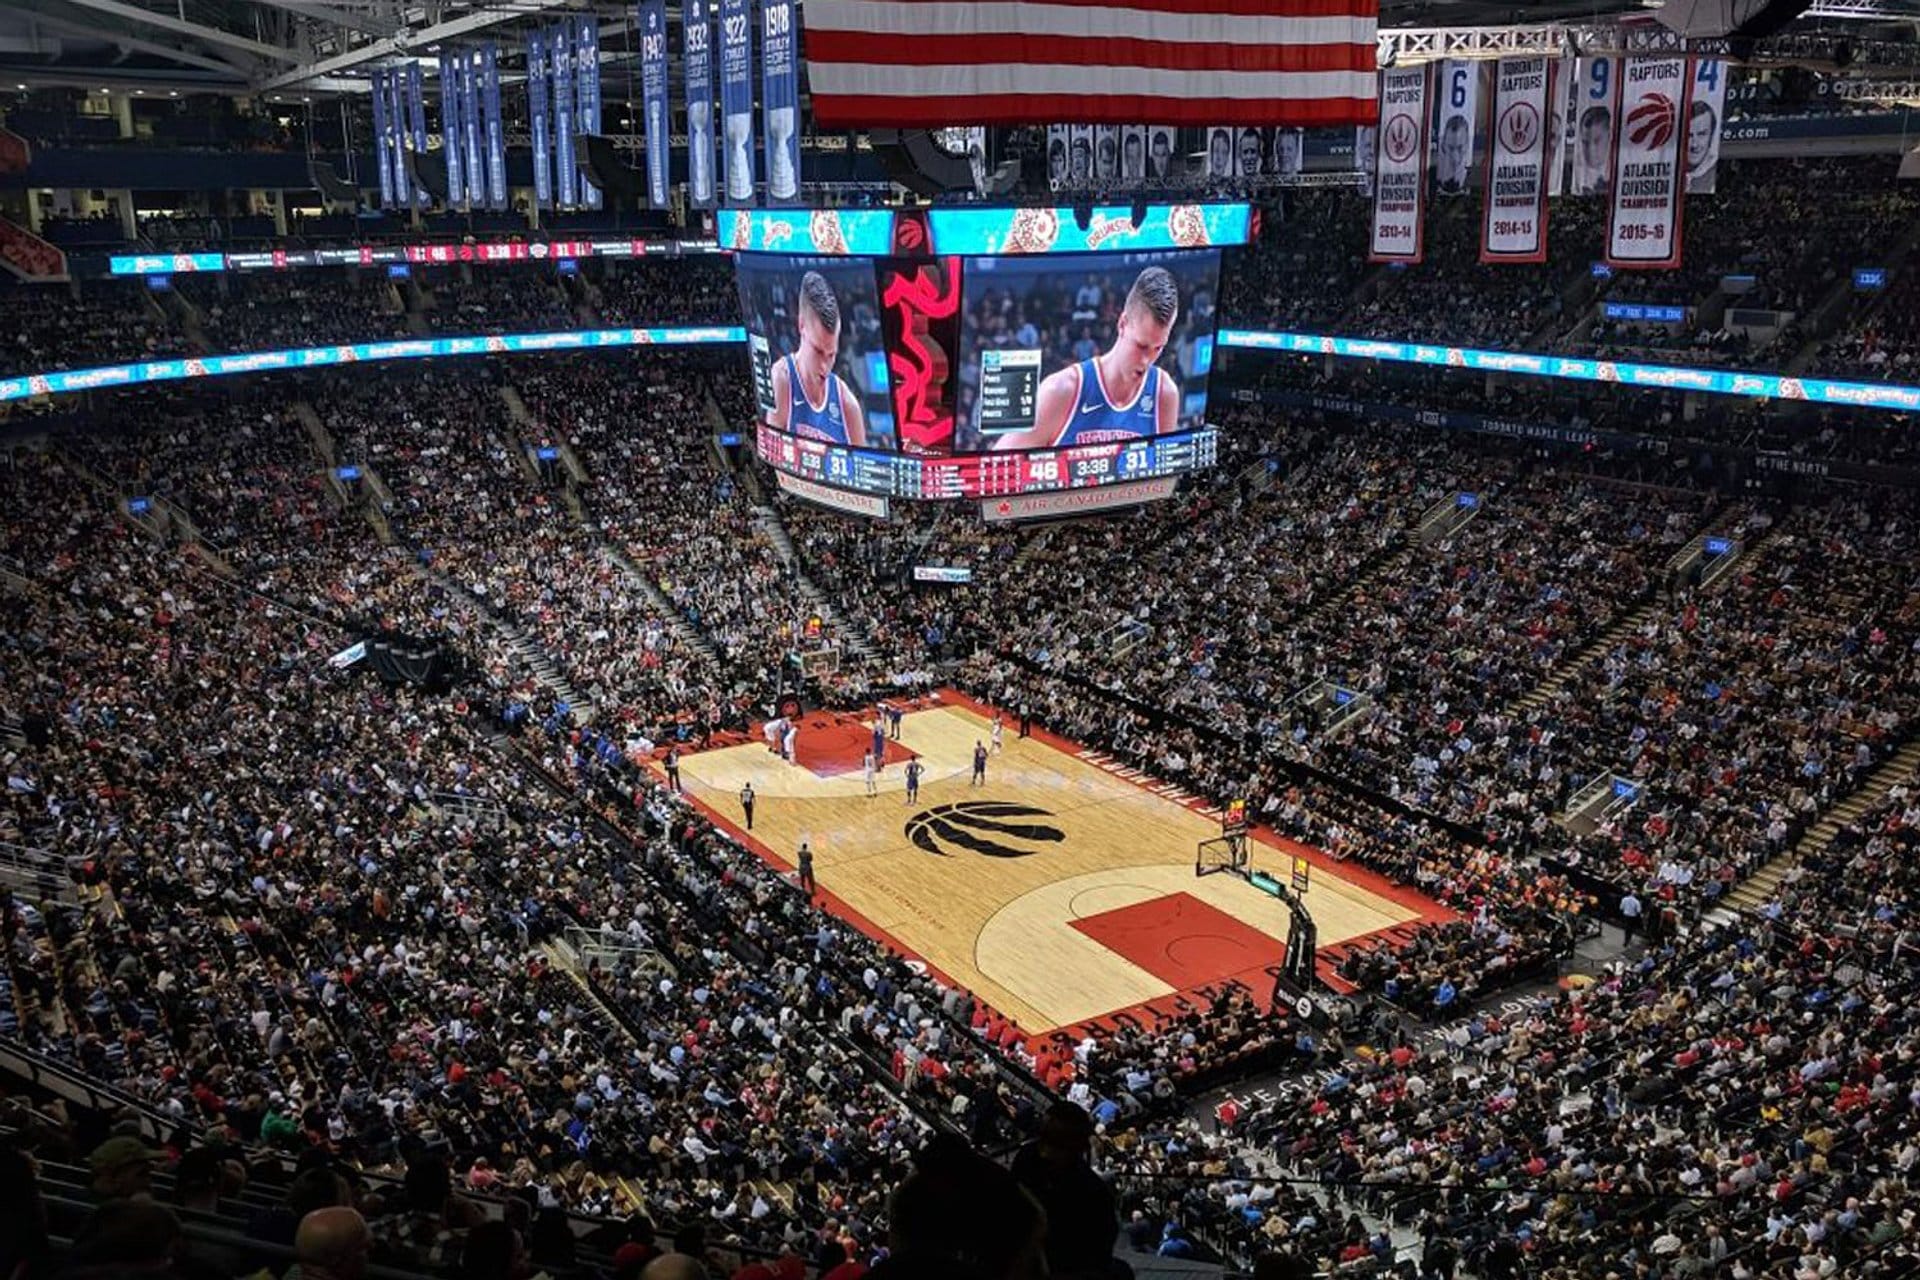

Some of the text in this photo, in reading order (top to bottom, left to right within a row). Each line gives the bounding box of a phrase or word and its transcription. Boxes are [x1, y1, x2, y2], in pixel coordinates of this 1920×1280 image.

[765, 3, 789, 37] 1918
[1589, 57, 1609, 99] 9
[1629, 62, 1681, 82] RAPTORS
[1697, 58, 1719, 92] 4
[1451, 70, 1467, 108] 6
[1501, 75, 1543, 91] RAPTORS
[1382, 172, 1416, 186] ATLANTIC
[1497, 164, 1537, 179] ATLANTIC
[1623, 163, 1671, 178] ATLANTIC
[1381, 187, 1416, 201] DIVISION
[1496, 180, 1536, 195] DIVISION
[1621, 179, 1669, 196] DIVISION
[1379, 224, 1411, 238] 2013-14
[1494, 220, 1532, 235] 2014-15
[1619, 223, 1664, 240] 2015-16
[831, 455, 849, 476] 31
[1077, 458, 1109, 476] 3:38
[1126, 450, 1148, 473] 31
[1030, 461, 1058, 481] 46
[1021, 500, 1047, 512] AIR
[1054, 492, 1113, 507] CANADA
